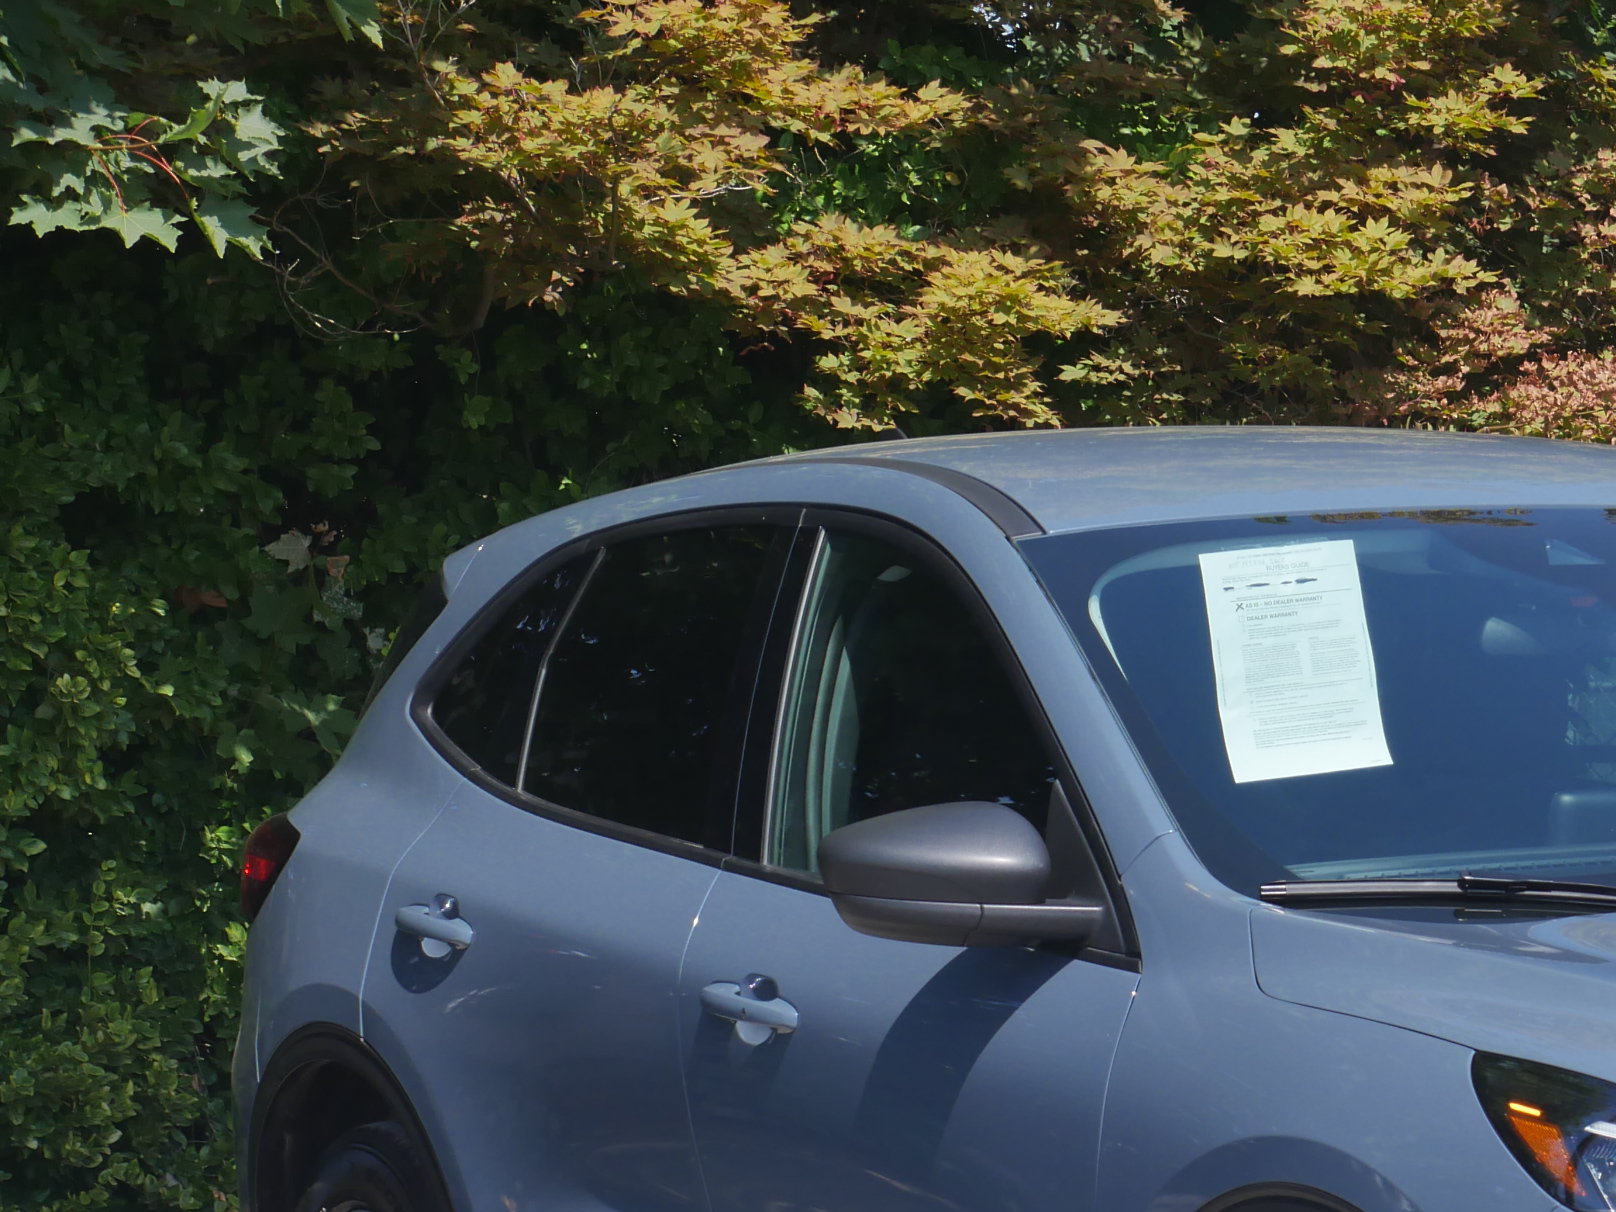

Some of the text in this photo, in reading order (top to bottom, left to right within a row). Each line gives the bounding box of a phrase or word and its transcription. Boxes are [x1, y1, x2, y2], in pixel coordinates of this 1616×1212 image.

[1295, 595, 1323, 603] WARRANTY
[1246, 611, 1298, 622] DEALER WARRANTY
